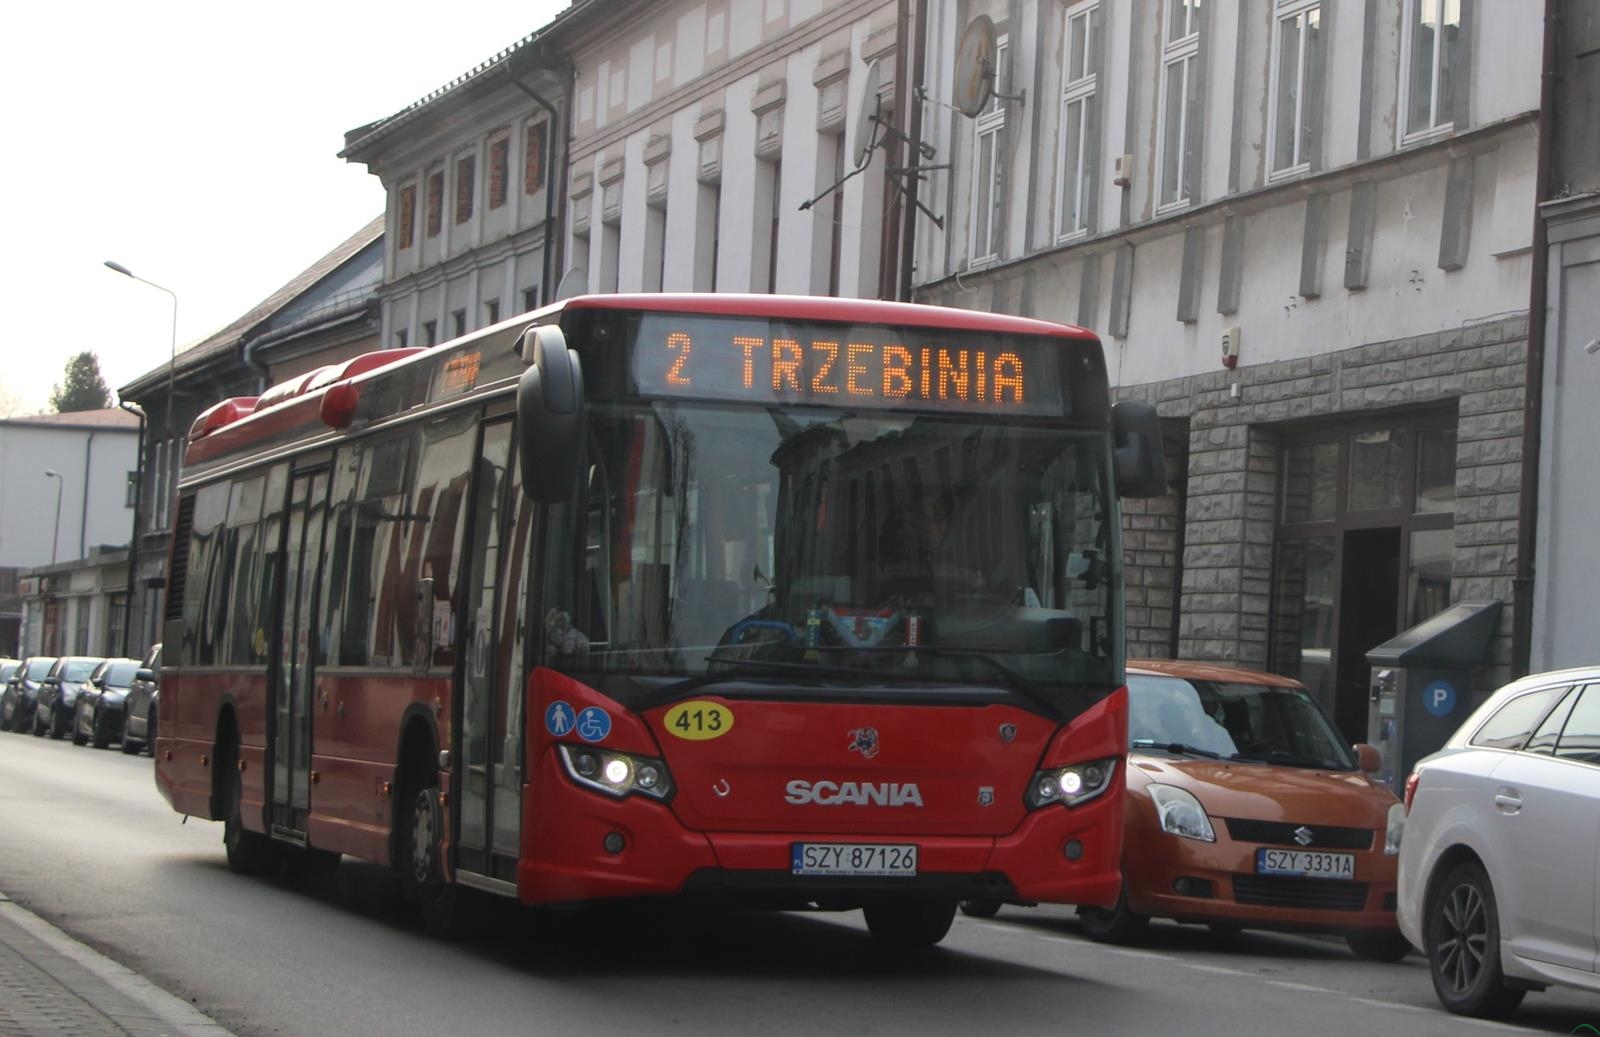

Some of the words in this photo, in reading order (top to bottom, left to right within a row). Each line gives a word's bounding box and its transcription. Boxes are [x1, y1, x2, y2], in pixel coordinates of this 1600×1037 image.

[667, 333, 691, 385] 2
[734, 336, 1024, 404] TRZEBINIA
[1433, 688, 1447, 707] P
[675, 709, 722, 732] 413
[785, 779, 924, 807] SCANIA
[804, 847, 844, 868] SZY
[851, 848, 914, 869] 87126
[1267, 851, 1298, 870] SZY
[1304, 854, 1351, 873] 3331A
